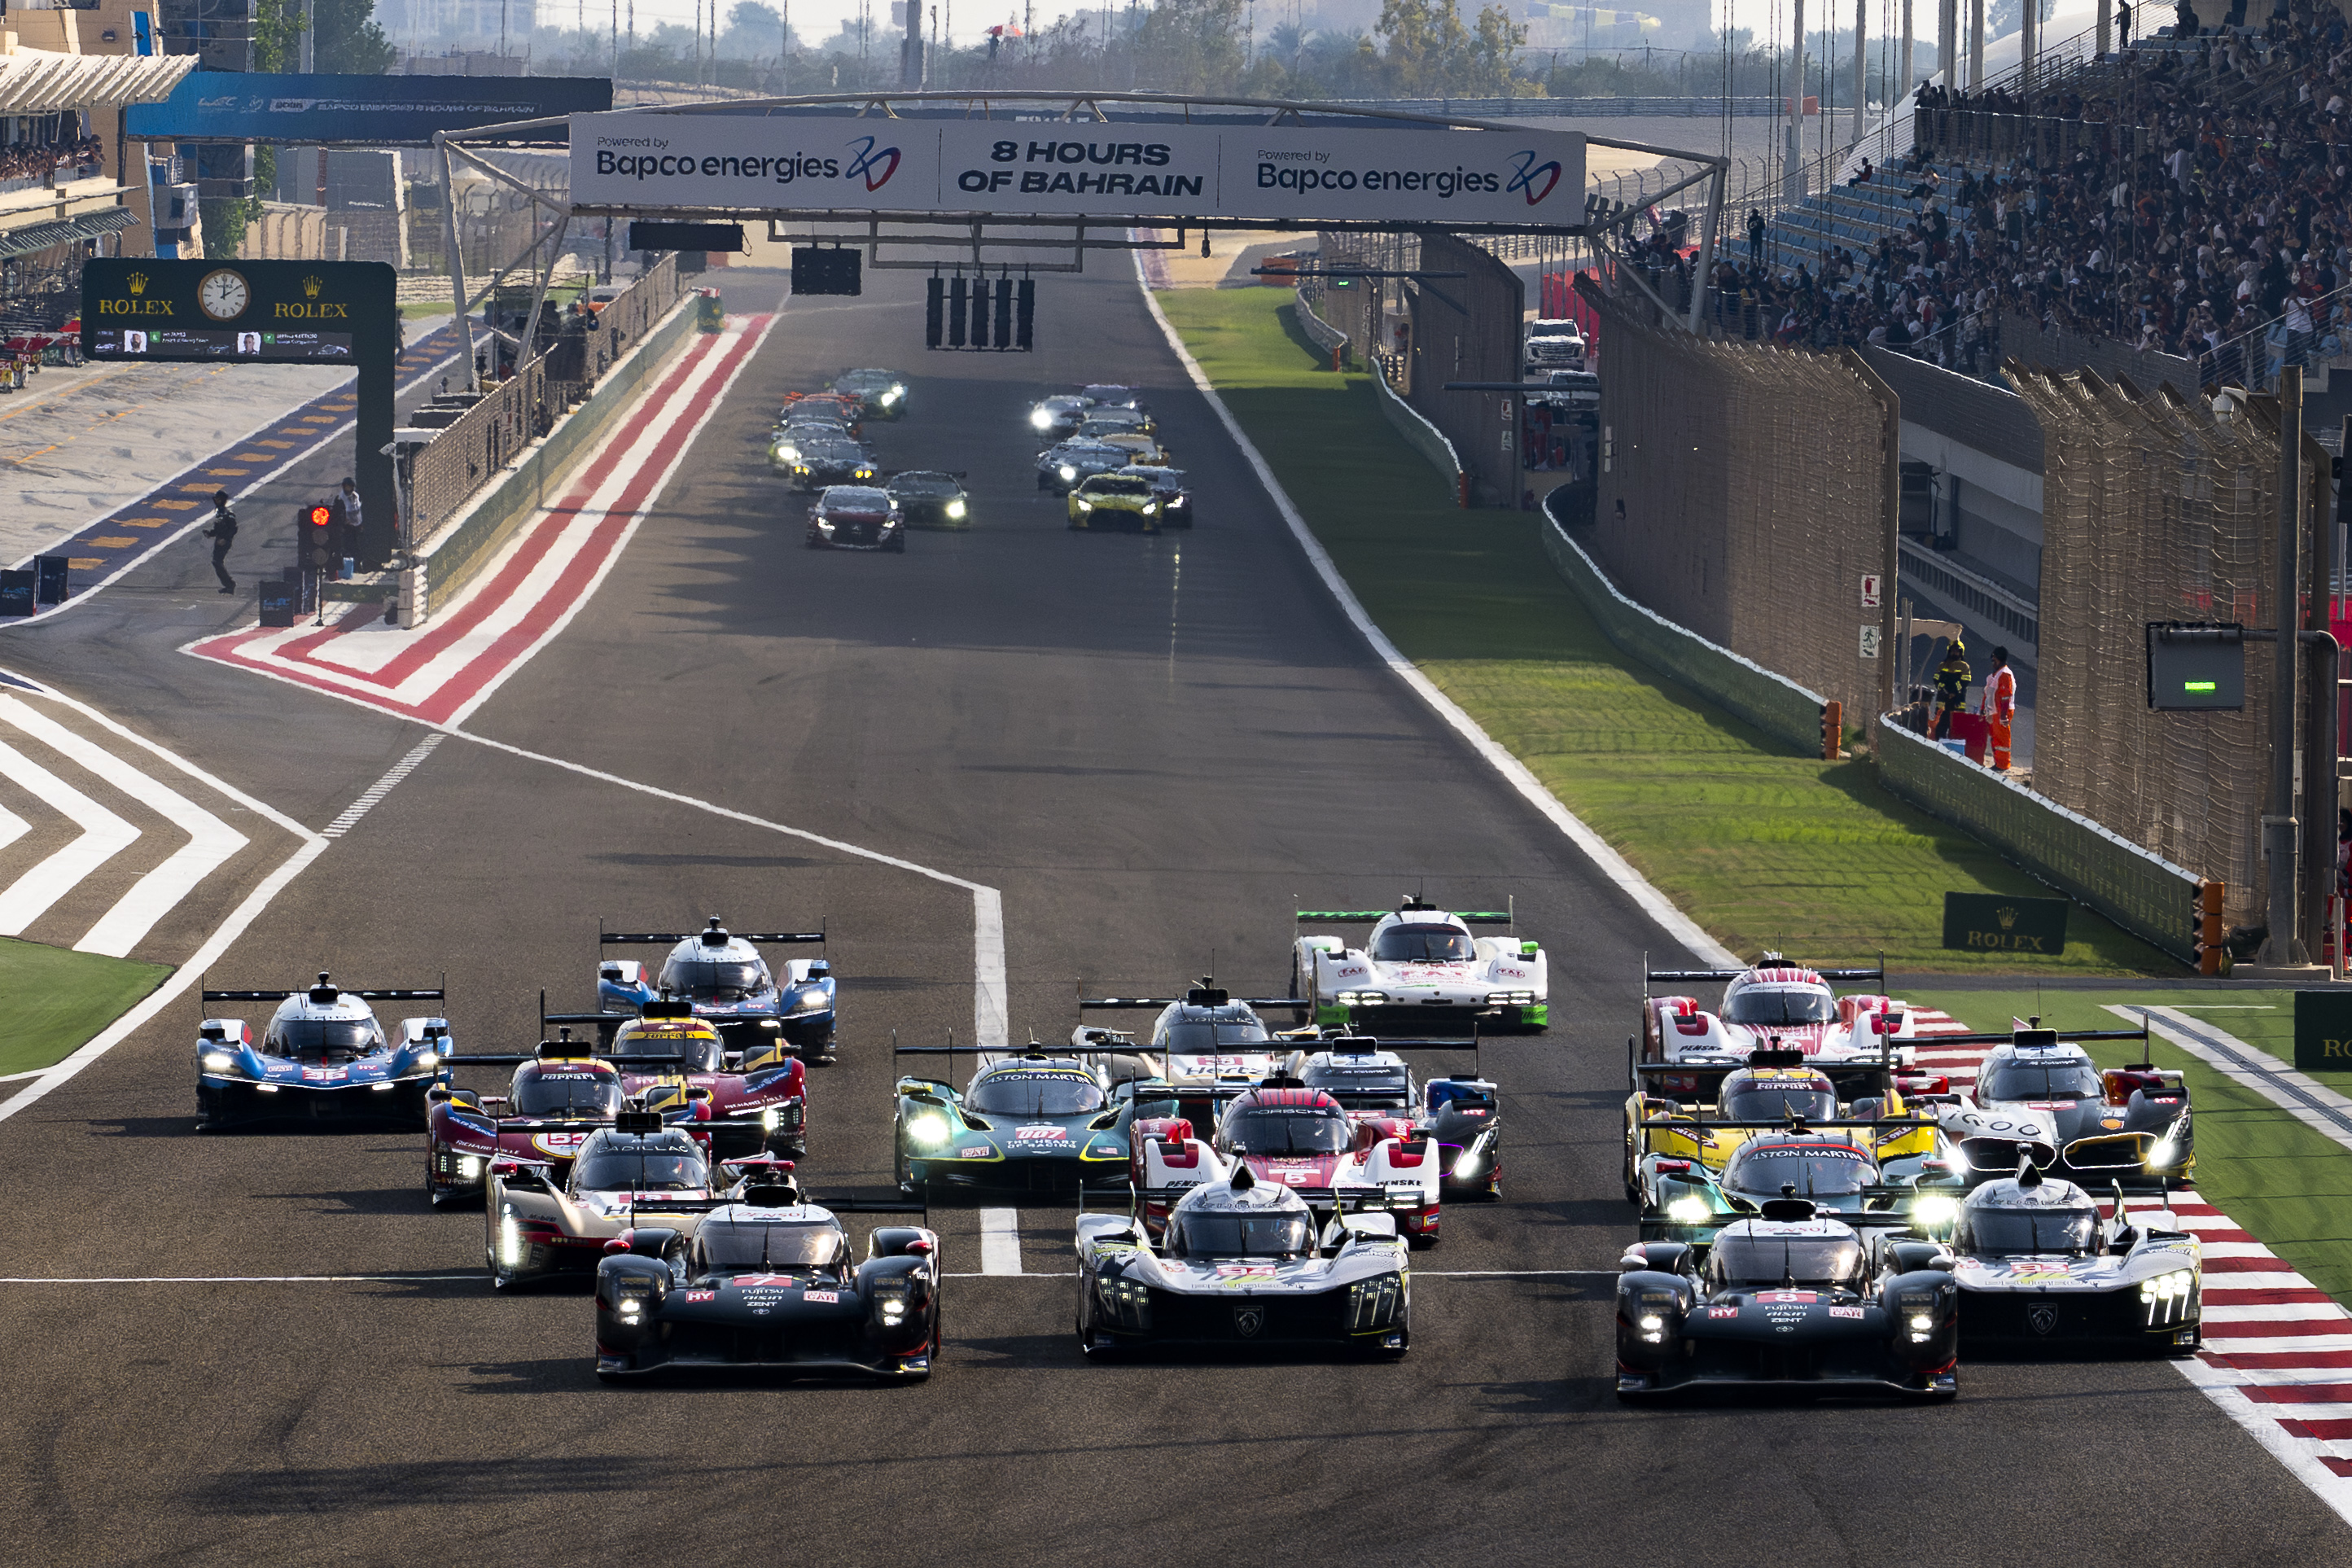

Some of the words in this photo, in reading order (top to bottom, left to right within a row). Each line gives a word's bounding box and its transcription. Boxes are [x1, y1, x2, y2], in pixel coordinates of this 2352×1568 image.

[598, 136, 650, 147] Powered
[654, 137, 669, 150] by
[990, 140, 1018, 163] 8
[1026, 141, 1171, 166] HOURS
[1258, 149, 1312, 161] Powered
[1315, 151, 1330, 163] by
[597, 150, 696, 181] Bapco
[701, 152, 839, 184] energies
[957, 169, 1014, 194] OF
[1020, 170, 1204, 197] BAHRAIN
[1257, 163, 1359, 195] Bapco
[1362, 165, 1500, 199] energies
[99, 300, 174, 315] ROLEX
[274, 303, 348, 318] ROLEX
[1968, 930, 2043, 952] ROLEX
[540, 1072, 597, 1081] Ferrari
[1186, 1067, 1264, 1075] Hertz
[986, 1073, 1032, 1084] ASTON
[1036, 1073, 1091, 1085] MARTIN
[1755, 1082, 1814, 1091] Ferrari
[1018, 1130, 1064, 1139] 007
[456, 1140, 493, 1151] RICHARD
[597, 1145, 690, 1153] CADILLAC
[1750, 1150, 1800, 1162] ASTON
[1804, 1150, 1864, 1162] MARTIN
[1284, 1172, 1307, 1184] 5
[1220, 1267, 1275, 1276] 94
[751, 1277, 776, 1286] 7
[688, 1292, 712, 1301] HY
[1775, 1293, 1798, 1303] 8
[1710, 1308, 1736, 1317] HY
